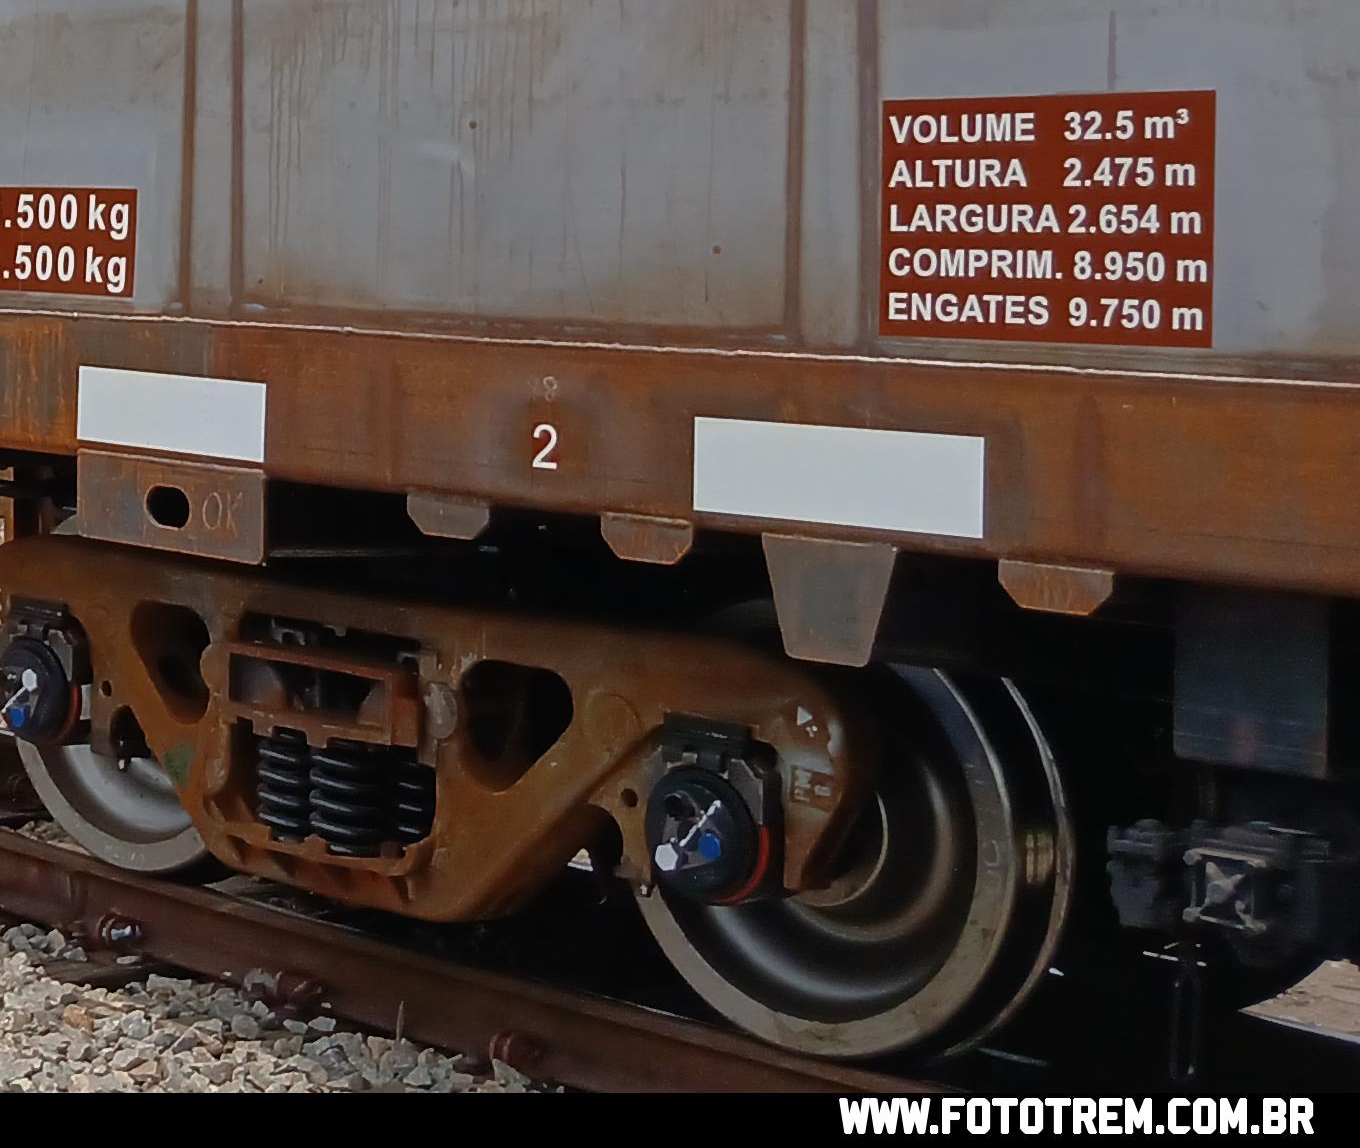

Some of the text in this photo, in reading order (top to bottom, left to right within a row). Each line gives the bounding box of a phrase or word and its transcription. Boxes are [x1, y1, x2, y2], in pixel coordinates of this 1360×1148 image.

[889, 112, 1036, 144] VOLUME
[1063, 109, 1135, 142] 32.5
[888, 156, 1197, 189] ALTURA 2.475 m
[88, 193, 130, 241] kg
[889, 202, 1202, 236] LARGURA 2.654 m
[85, 245, 128, 295] kg
[888, 246, 1208, 284] COMPRIM. 8.950 m
[887, 292, 1204, 332] ENGATES 9.750 m
[532, 423, 558, 470] 2
[202, 492, 243, 538] OK
